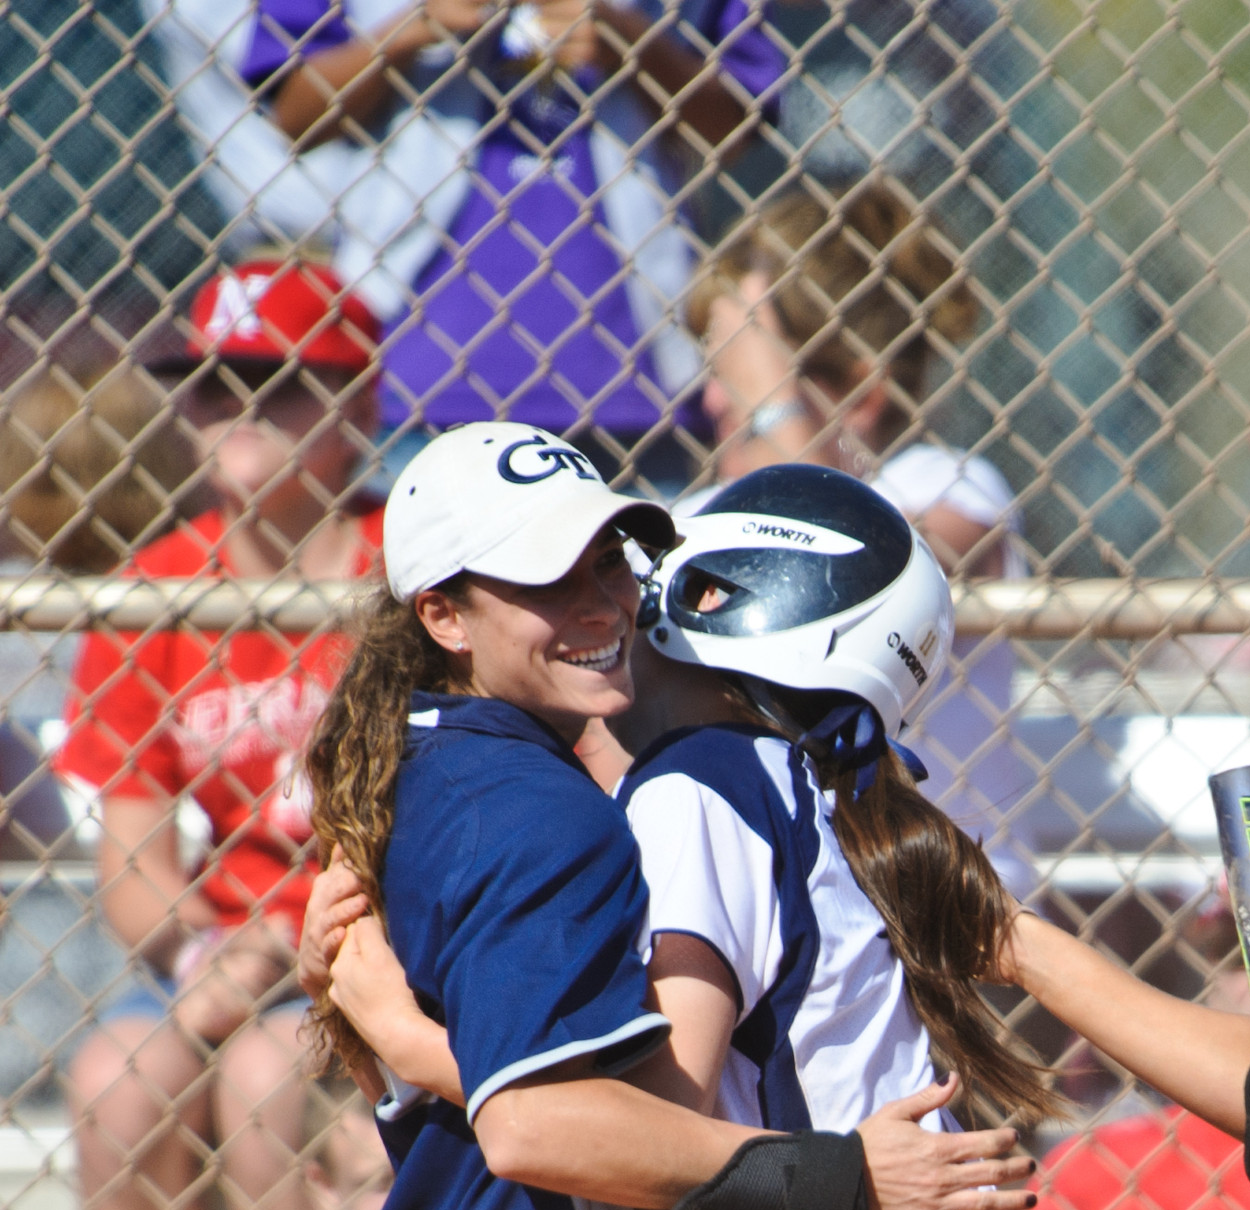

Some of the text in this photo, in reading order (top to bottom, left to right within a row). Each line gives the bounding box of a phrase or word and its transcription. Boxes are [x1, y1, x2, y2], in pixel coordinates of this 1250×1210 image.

[497, 434, 598, 485] GT
[757, 523, 817, 546] WORTH
[896, 641, 928, 688] WORTH
